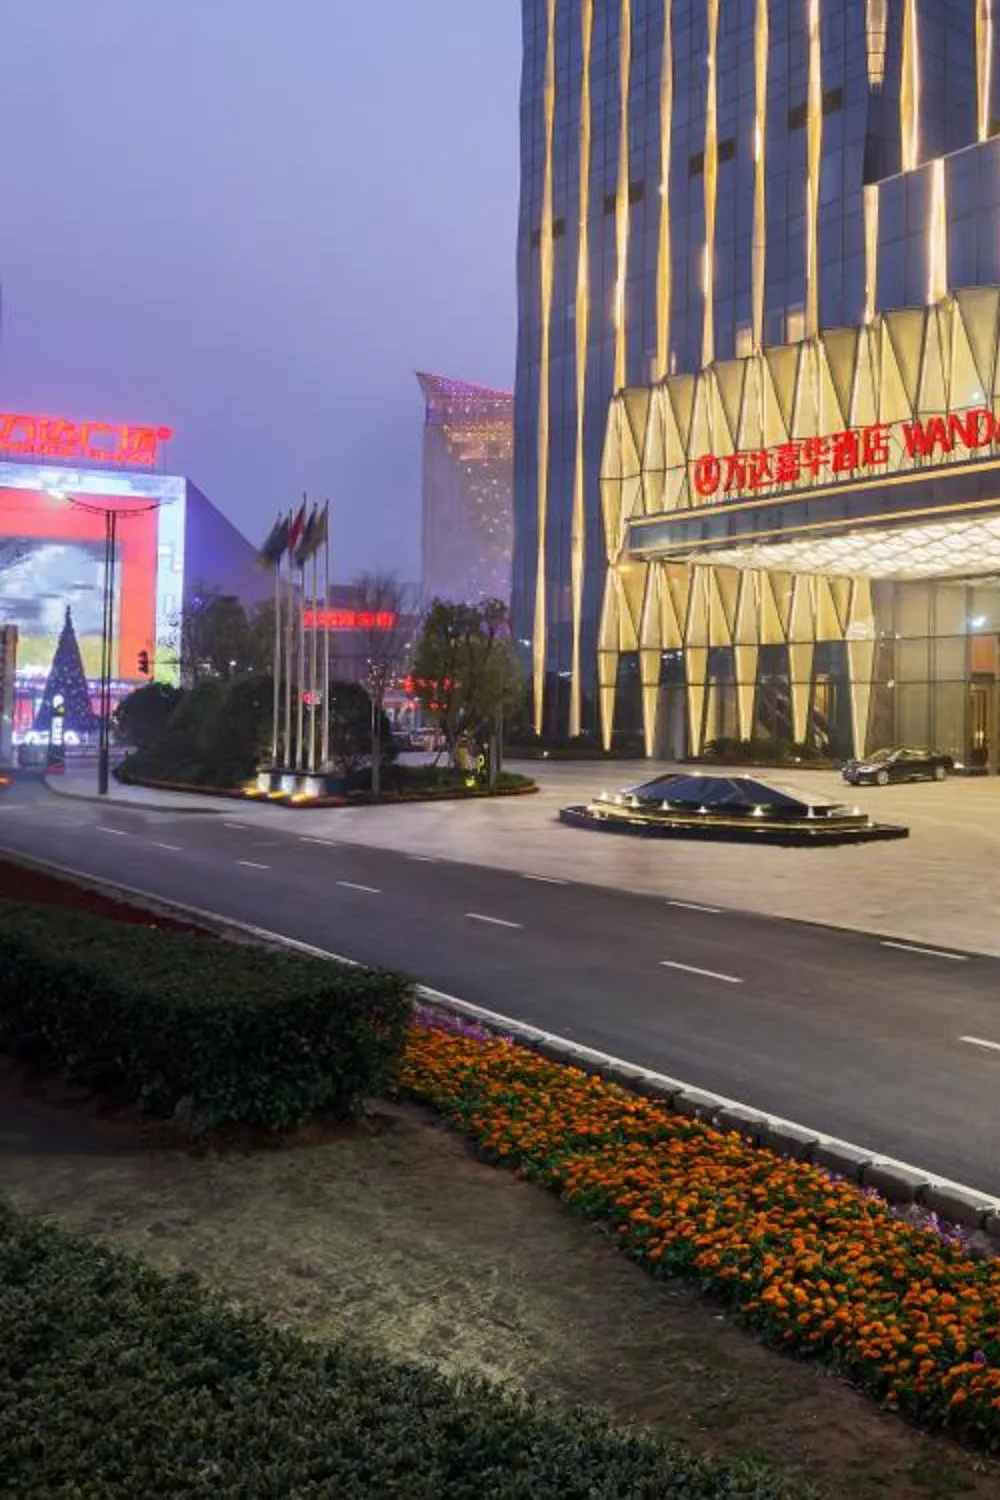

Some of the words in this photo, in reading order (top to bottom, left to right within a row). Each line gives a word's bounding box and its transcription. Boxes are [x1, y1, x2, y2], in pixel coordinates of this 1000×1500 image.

[724, 422, 892, 492] 万达嘉华酒店
